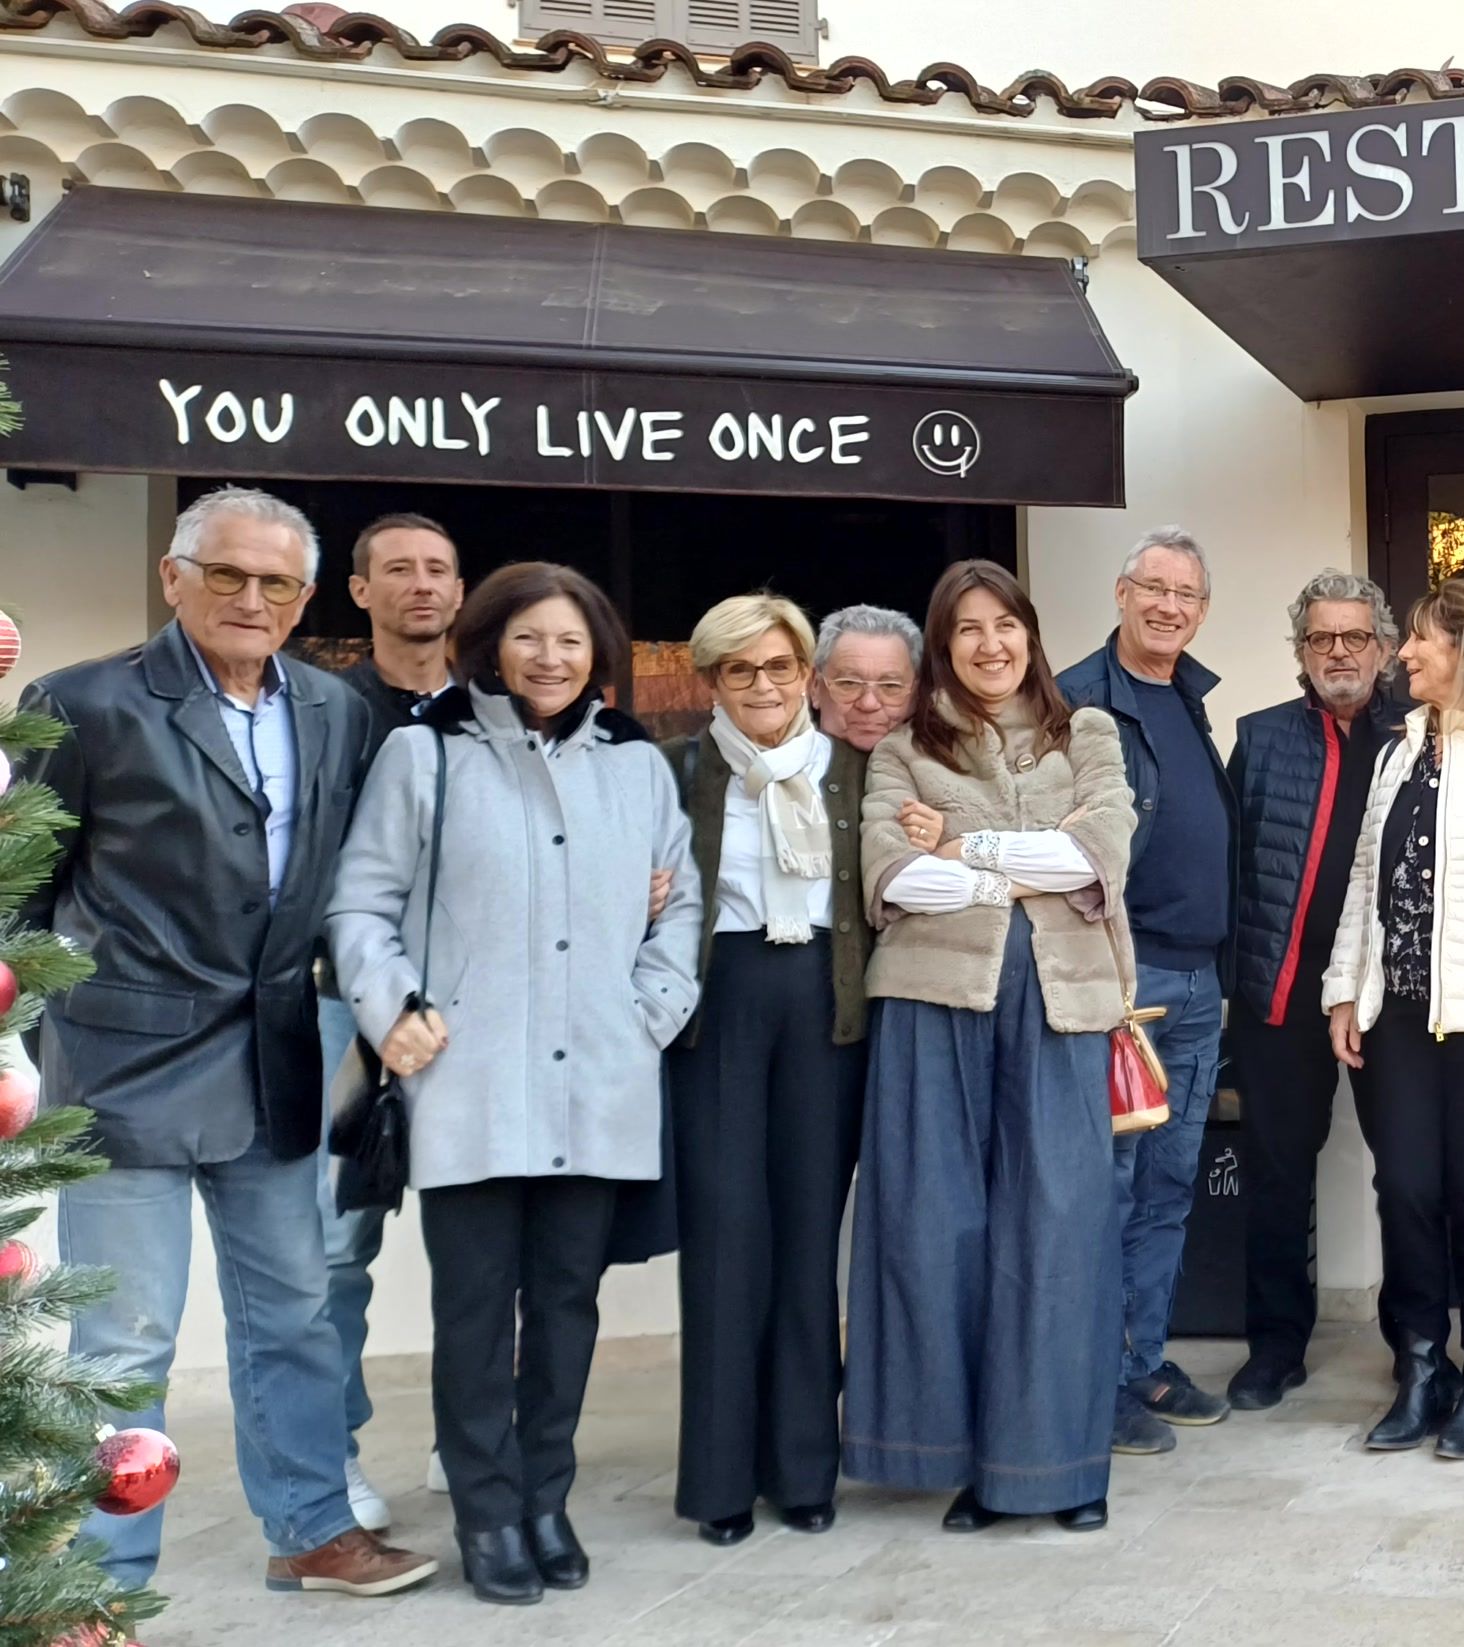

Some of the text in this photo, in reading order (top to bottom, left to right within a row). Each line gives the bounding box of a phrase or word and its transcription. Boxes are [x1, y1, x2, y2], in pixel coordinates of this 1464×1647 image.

[159, 378, 870, 464] YOU ONLY LIVE ONCE
